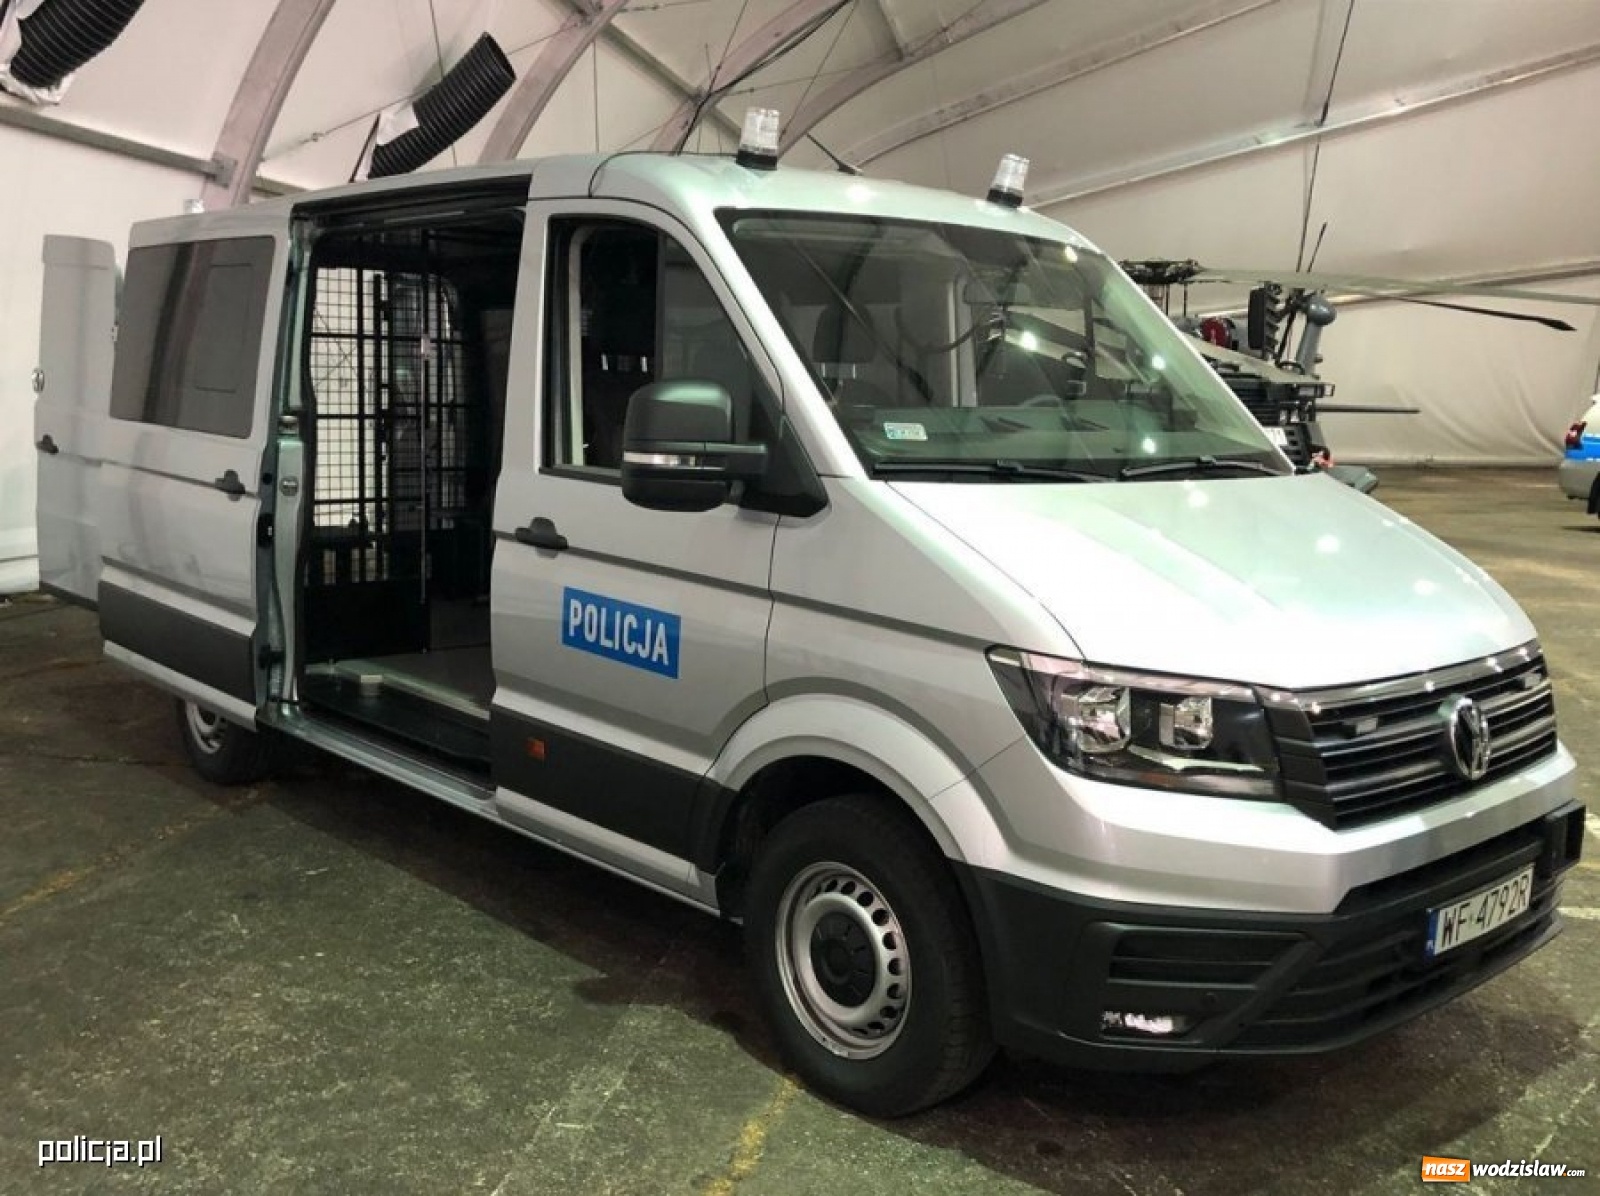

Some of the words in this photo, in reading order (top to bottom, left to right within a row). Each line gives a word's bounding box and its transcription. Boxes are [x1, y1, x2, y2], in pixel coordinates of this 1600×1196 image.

[568, 598, 669, 666] POLICJA
[1441, 902, 1470, 948] WF
[1476, 873, 1530, 930] 4792R
